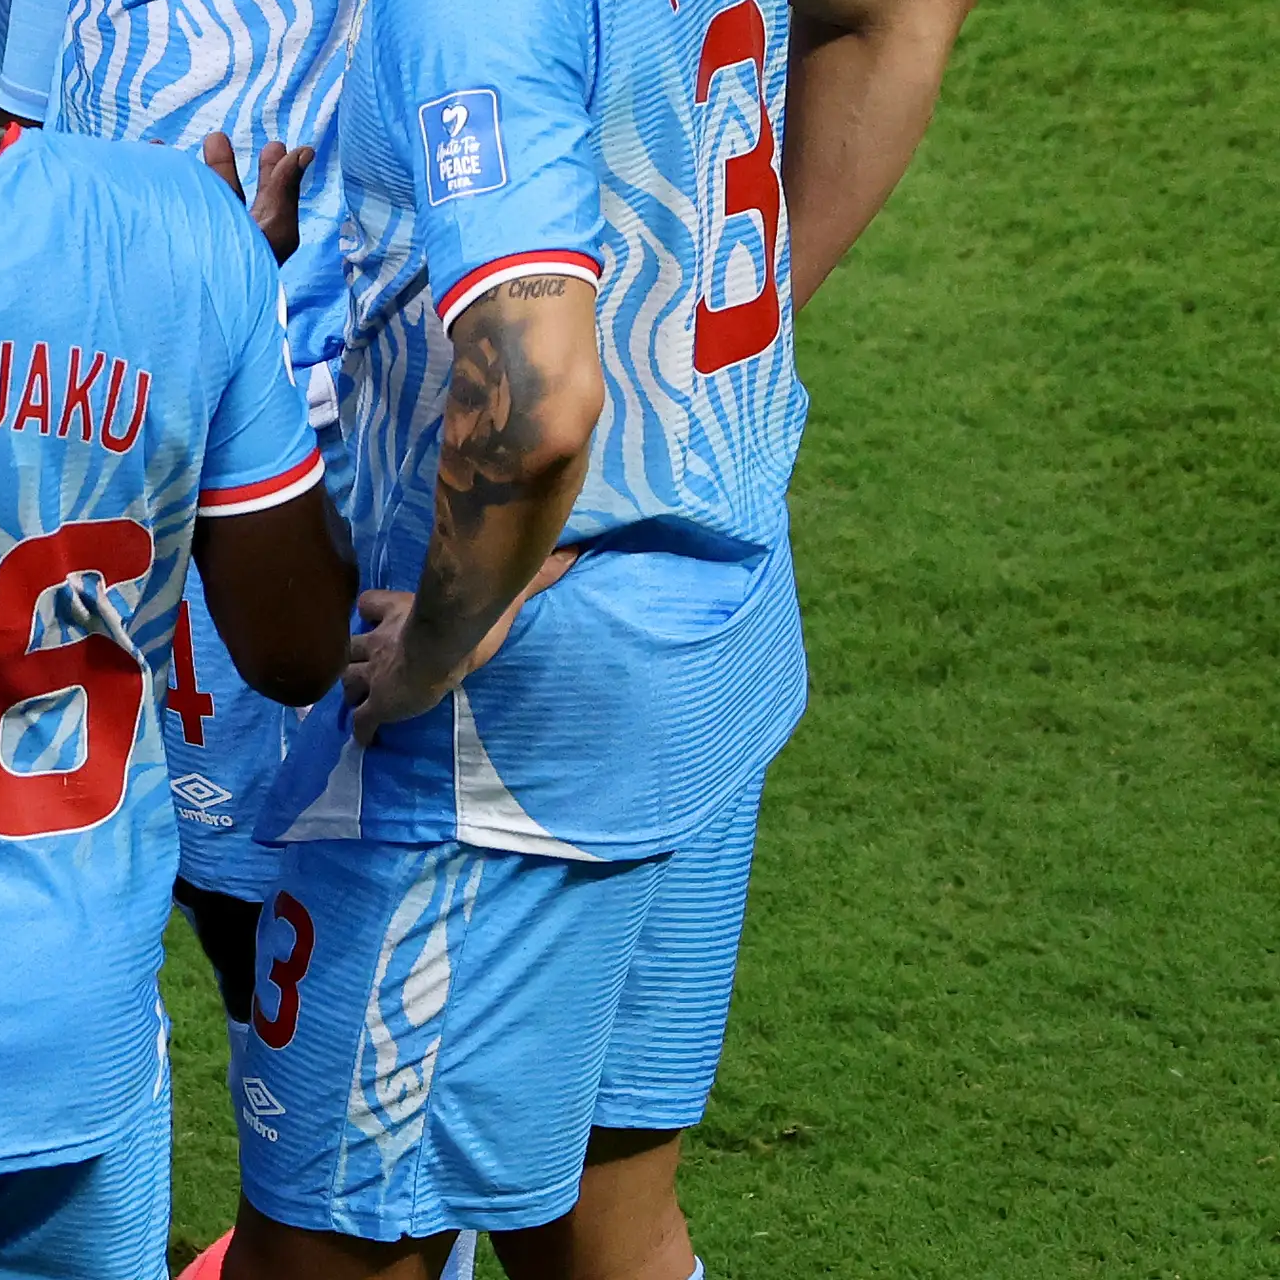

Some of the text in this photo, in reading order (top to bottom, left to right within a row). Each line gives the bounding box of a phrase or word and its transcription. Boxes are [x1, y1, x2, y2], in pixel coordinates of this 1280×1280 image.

[439, 156, 481, 181] PEACE
[508, 278, 567, 301] CHOICE
[166, 599, 215, 749] 4
[177, 805, 233, 827] umbro
[251, 889, 316, 1051] 3
